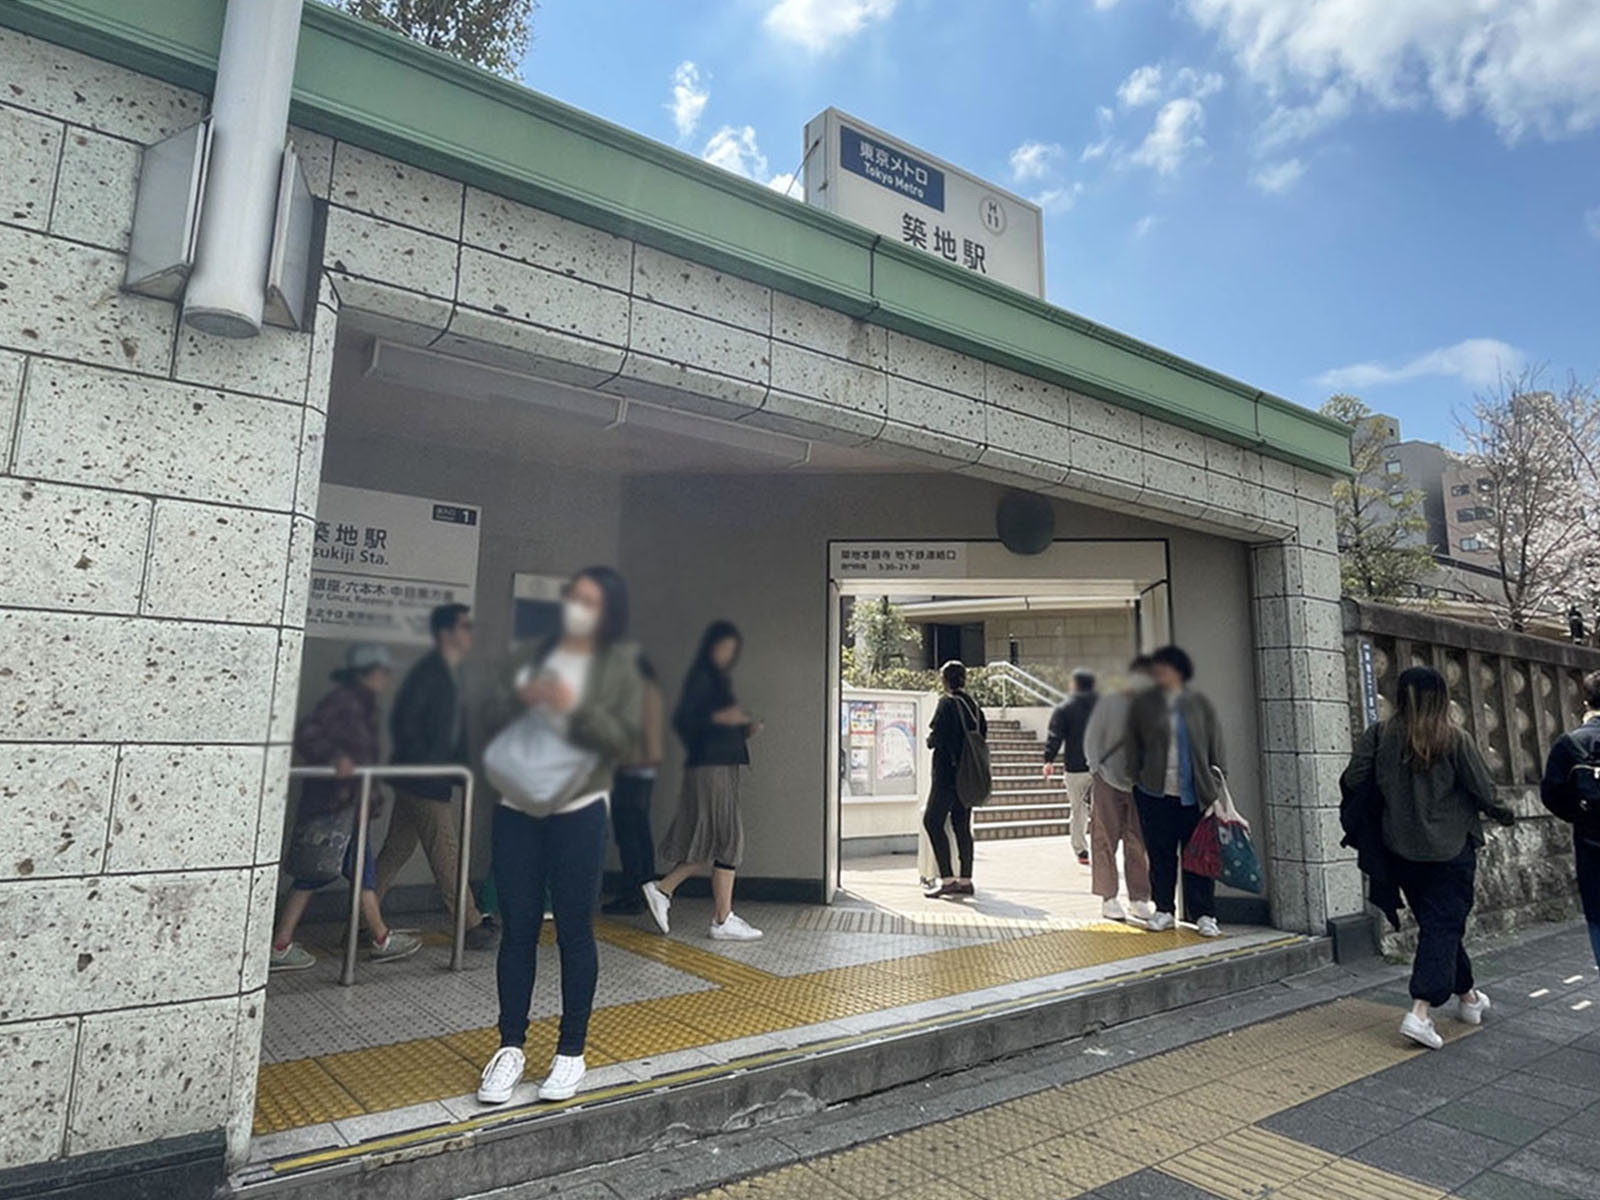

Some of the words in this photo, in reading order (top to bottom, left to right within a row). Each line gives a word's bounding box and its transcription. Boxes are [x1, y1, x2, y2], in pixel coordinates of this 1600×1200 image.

[859, 140, 928, 187] 東京メトロ
[863, 161, 893, 184] Tokyo
[895, 176, 924, 198] Metro
[987, 214, 998, 228] 11
[988, 203, 998, 214] H
[902, 212, 987, 274] 築地駅
[312, 546, 355, 565] sukiji
[360, 549, 389, 566] Sta.
